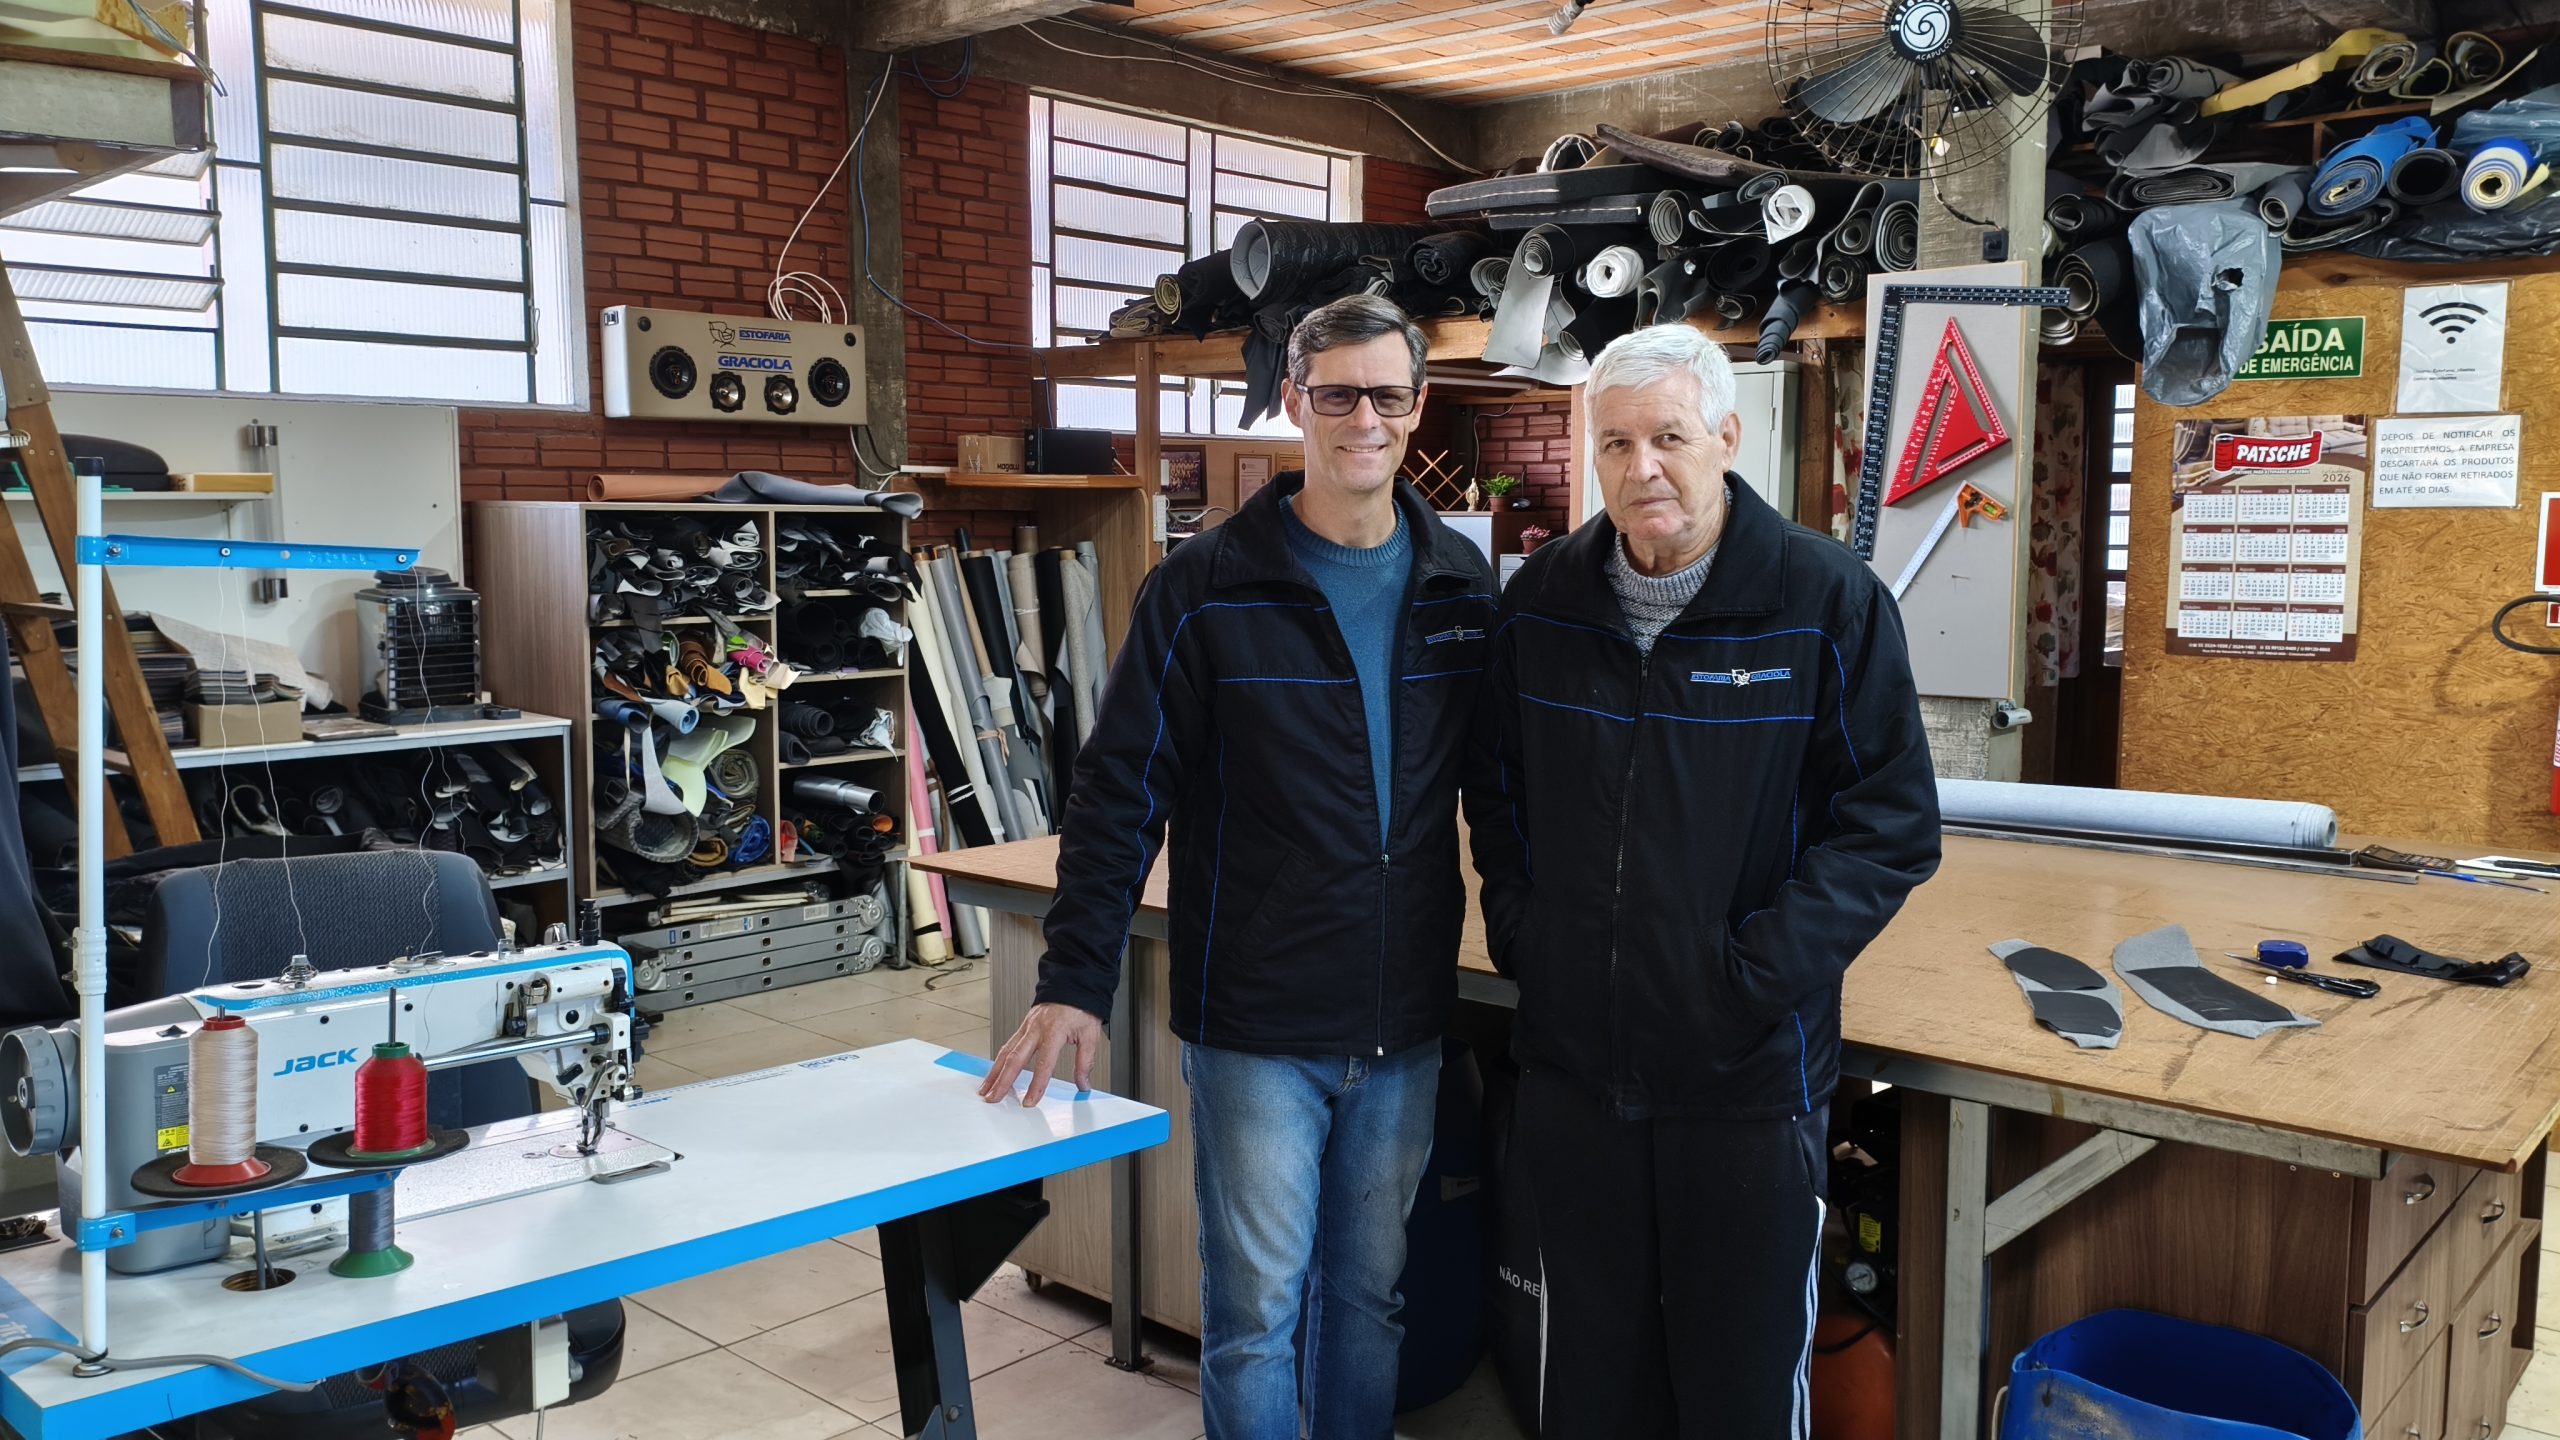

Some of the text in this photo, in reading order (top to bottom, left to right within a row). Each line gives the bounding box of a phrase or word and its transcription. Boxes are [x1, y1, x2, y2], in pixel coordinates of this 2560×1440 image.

[1915, 38, 1953, 60] ACAPULCO
[739, 329, 791, 341] ESTOFARIA
[718, 355, 792, 370] GRACIOLA
[2261, 353, 2354, 373] EMERGÊNCIA
[2381, 429, 2516, 441] DEPOIS DE NOTIFICAR OS
[2236, 443, 2313, 463] PATSCHE
[2470, 444, 2514, 452] EMPRESA
[2380, 458, 2439, 468] DESCARTARÁ
[2462, 457, 2514, 465] PRODUTOS
[2322, 473, 2351, 482] 2026
[2380, 470, 2514, 482] QUE NÃO FOREM RETIRADOS
[2379, 487, 2394, 495] EM
[2395, 485, 2413, 494] ATÉ
[2415, 486, 2426, 494] 90
[1499, 1265, 1520, 1287] NÃO
